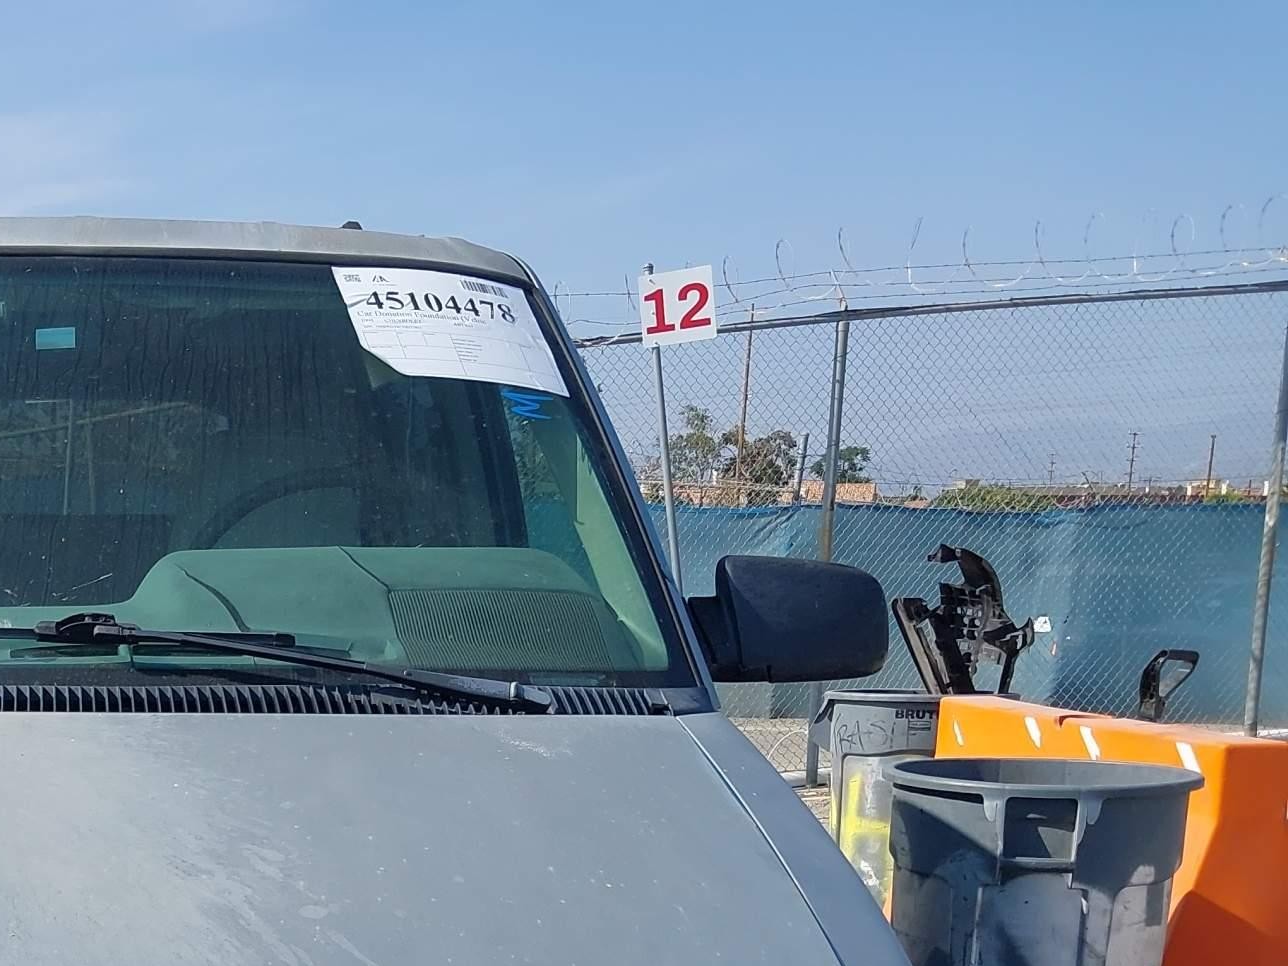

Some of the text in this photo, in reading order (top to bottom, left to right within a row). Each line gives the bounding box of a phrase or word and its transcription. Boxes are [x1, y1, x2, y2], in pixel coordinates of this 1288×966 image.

[366, 290, 516, 323] 45104478
[374, 310, 413, 318] Donation
[644, 282, 711, 335] 12
[895, 709, 940, 720] BRUT
